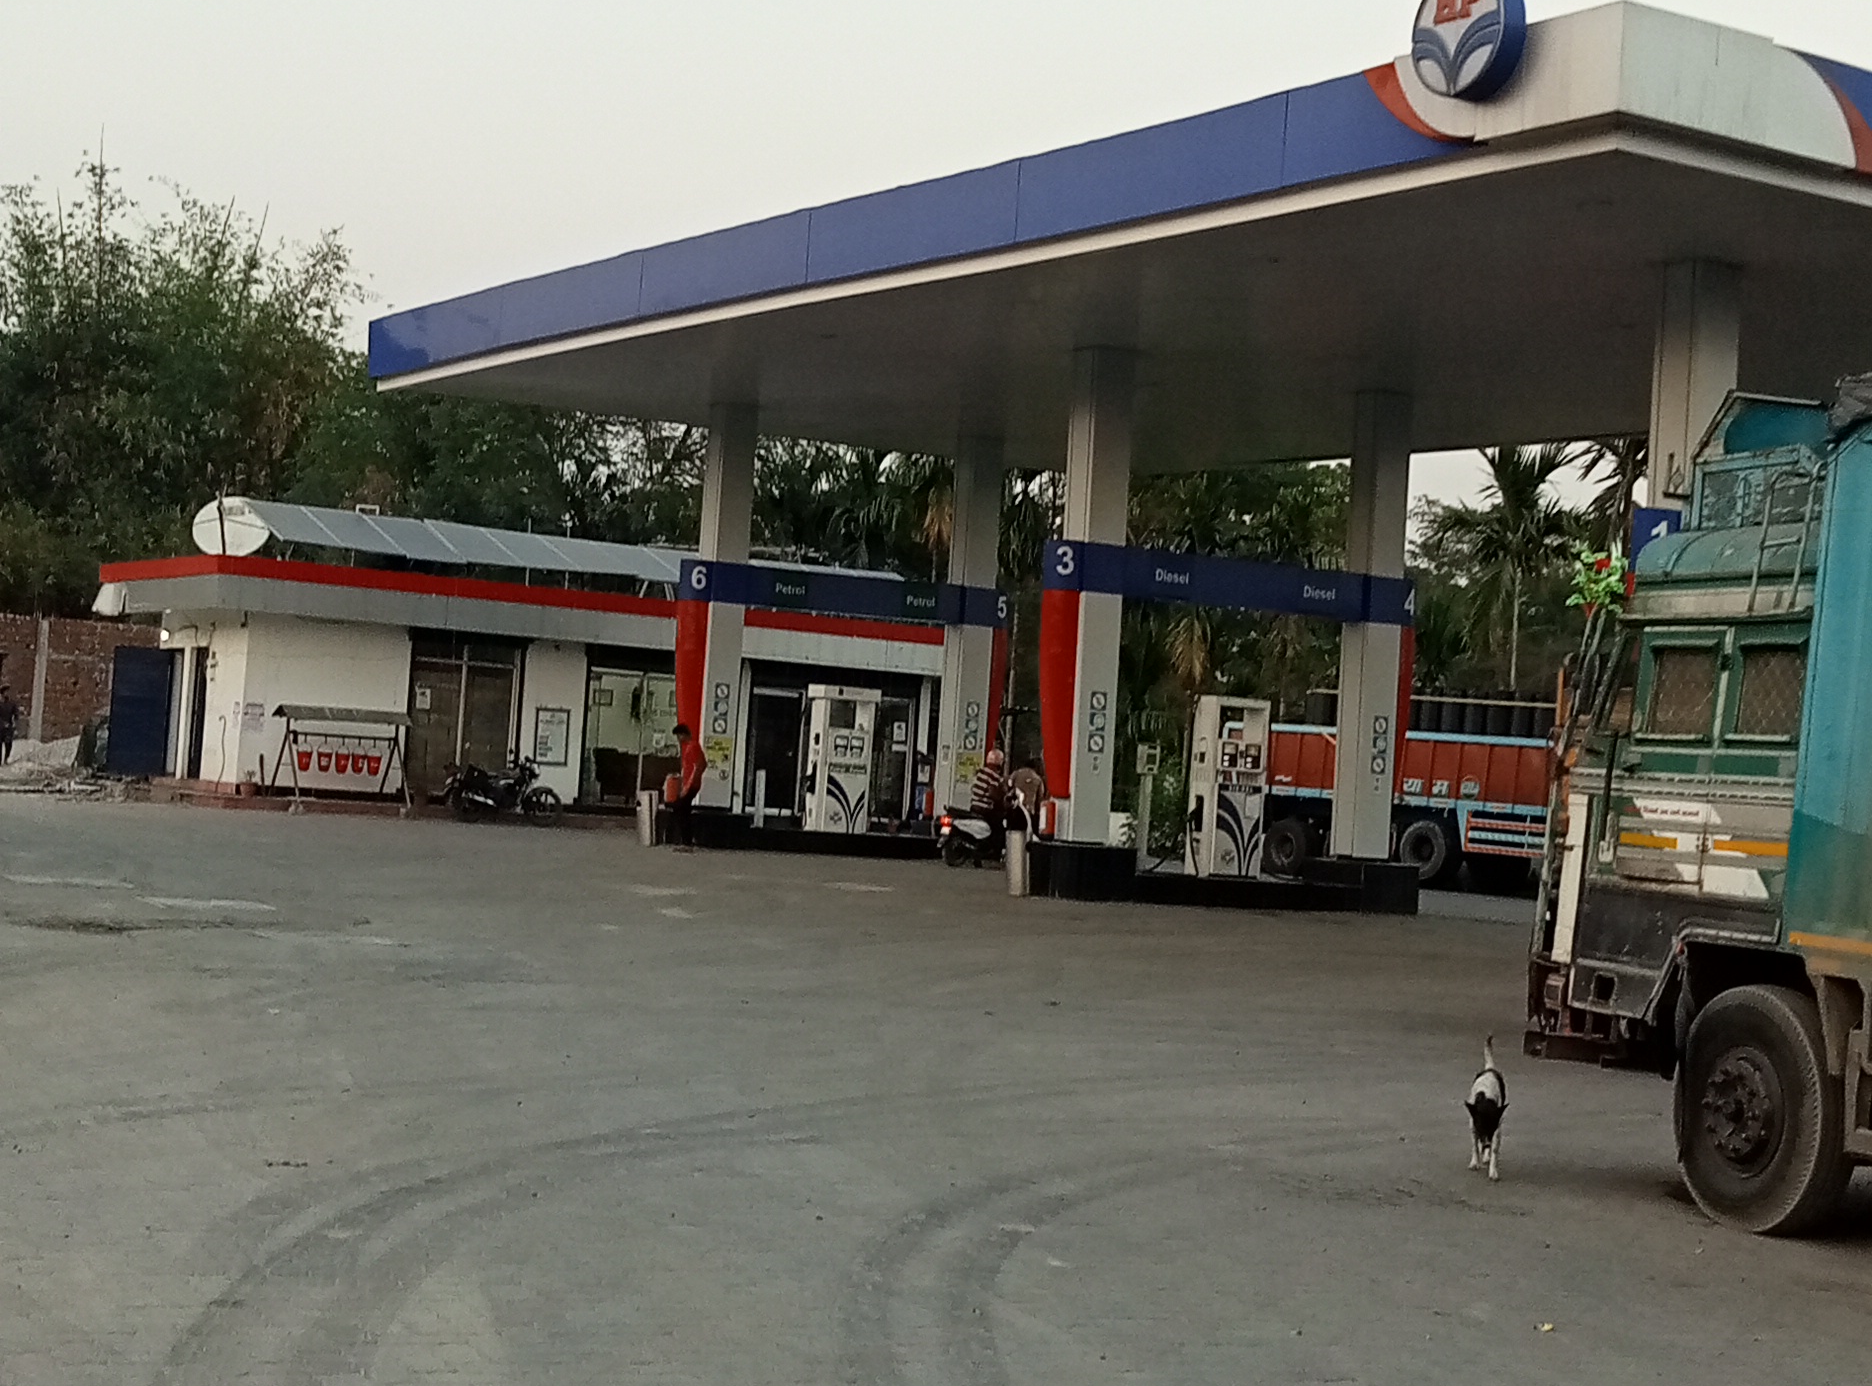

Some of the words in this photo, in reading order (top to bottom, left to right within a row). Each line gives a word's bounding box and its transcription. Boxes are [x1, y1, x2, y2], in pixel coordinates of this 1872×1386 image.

[1055, 545, 1075, 576] 3
[691, 565, 707, 590] 6
[1155, 568, 1189, 584] Diesel
[775, 582, 805, 595] Petrol
[1303, 585, 1336, 600] Diesel
[906, 595, 936, 608] Petrol
[997, 596, 1007, 618] 5
[1403, 588, 1415, 616] 4
